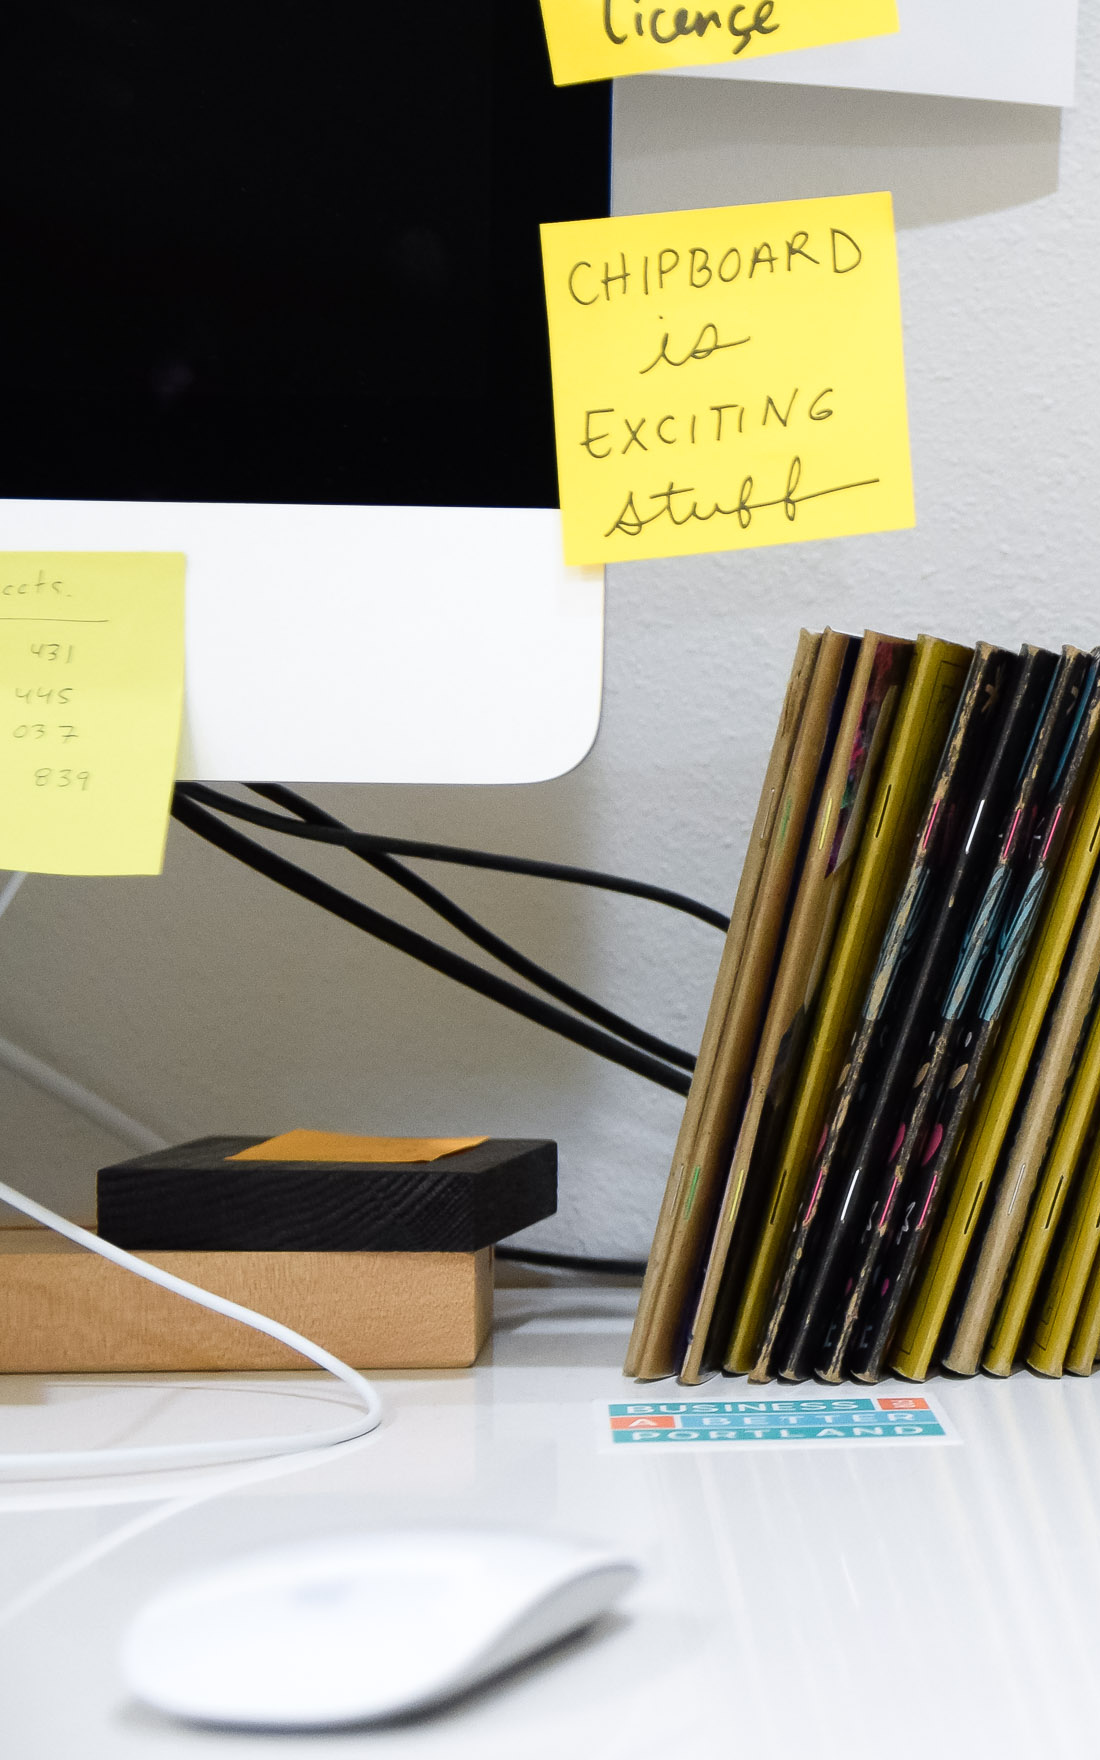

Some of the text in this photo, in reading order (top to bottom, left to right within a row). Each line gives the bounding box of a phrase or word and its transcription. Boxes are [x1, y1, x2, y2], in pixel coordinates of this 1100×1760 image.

[568, 227, 862, 306] CHIPBOARD
[639, 315, 751, 375] is
[580, 387, 834, 459] EXCITING
[603, 456, 880, 538] stuff
[30, 643, 76, 664] 431
[14, 687, 75, 705] 445
[34, 767, 90, 791] 839
[626, 1400, 859, 1415] BUSINESS
[628, 1412, 916, 1428] A BETTER
[631, 1425, 924, 1441] PORTLAND
